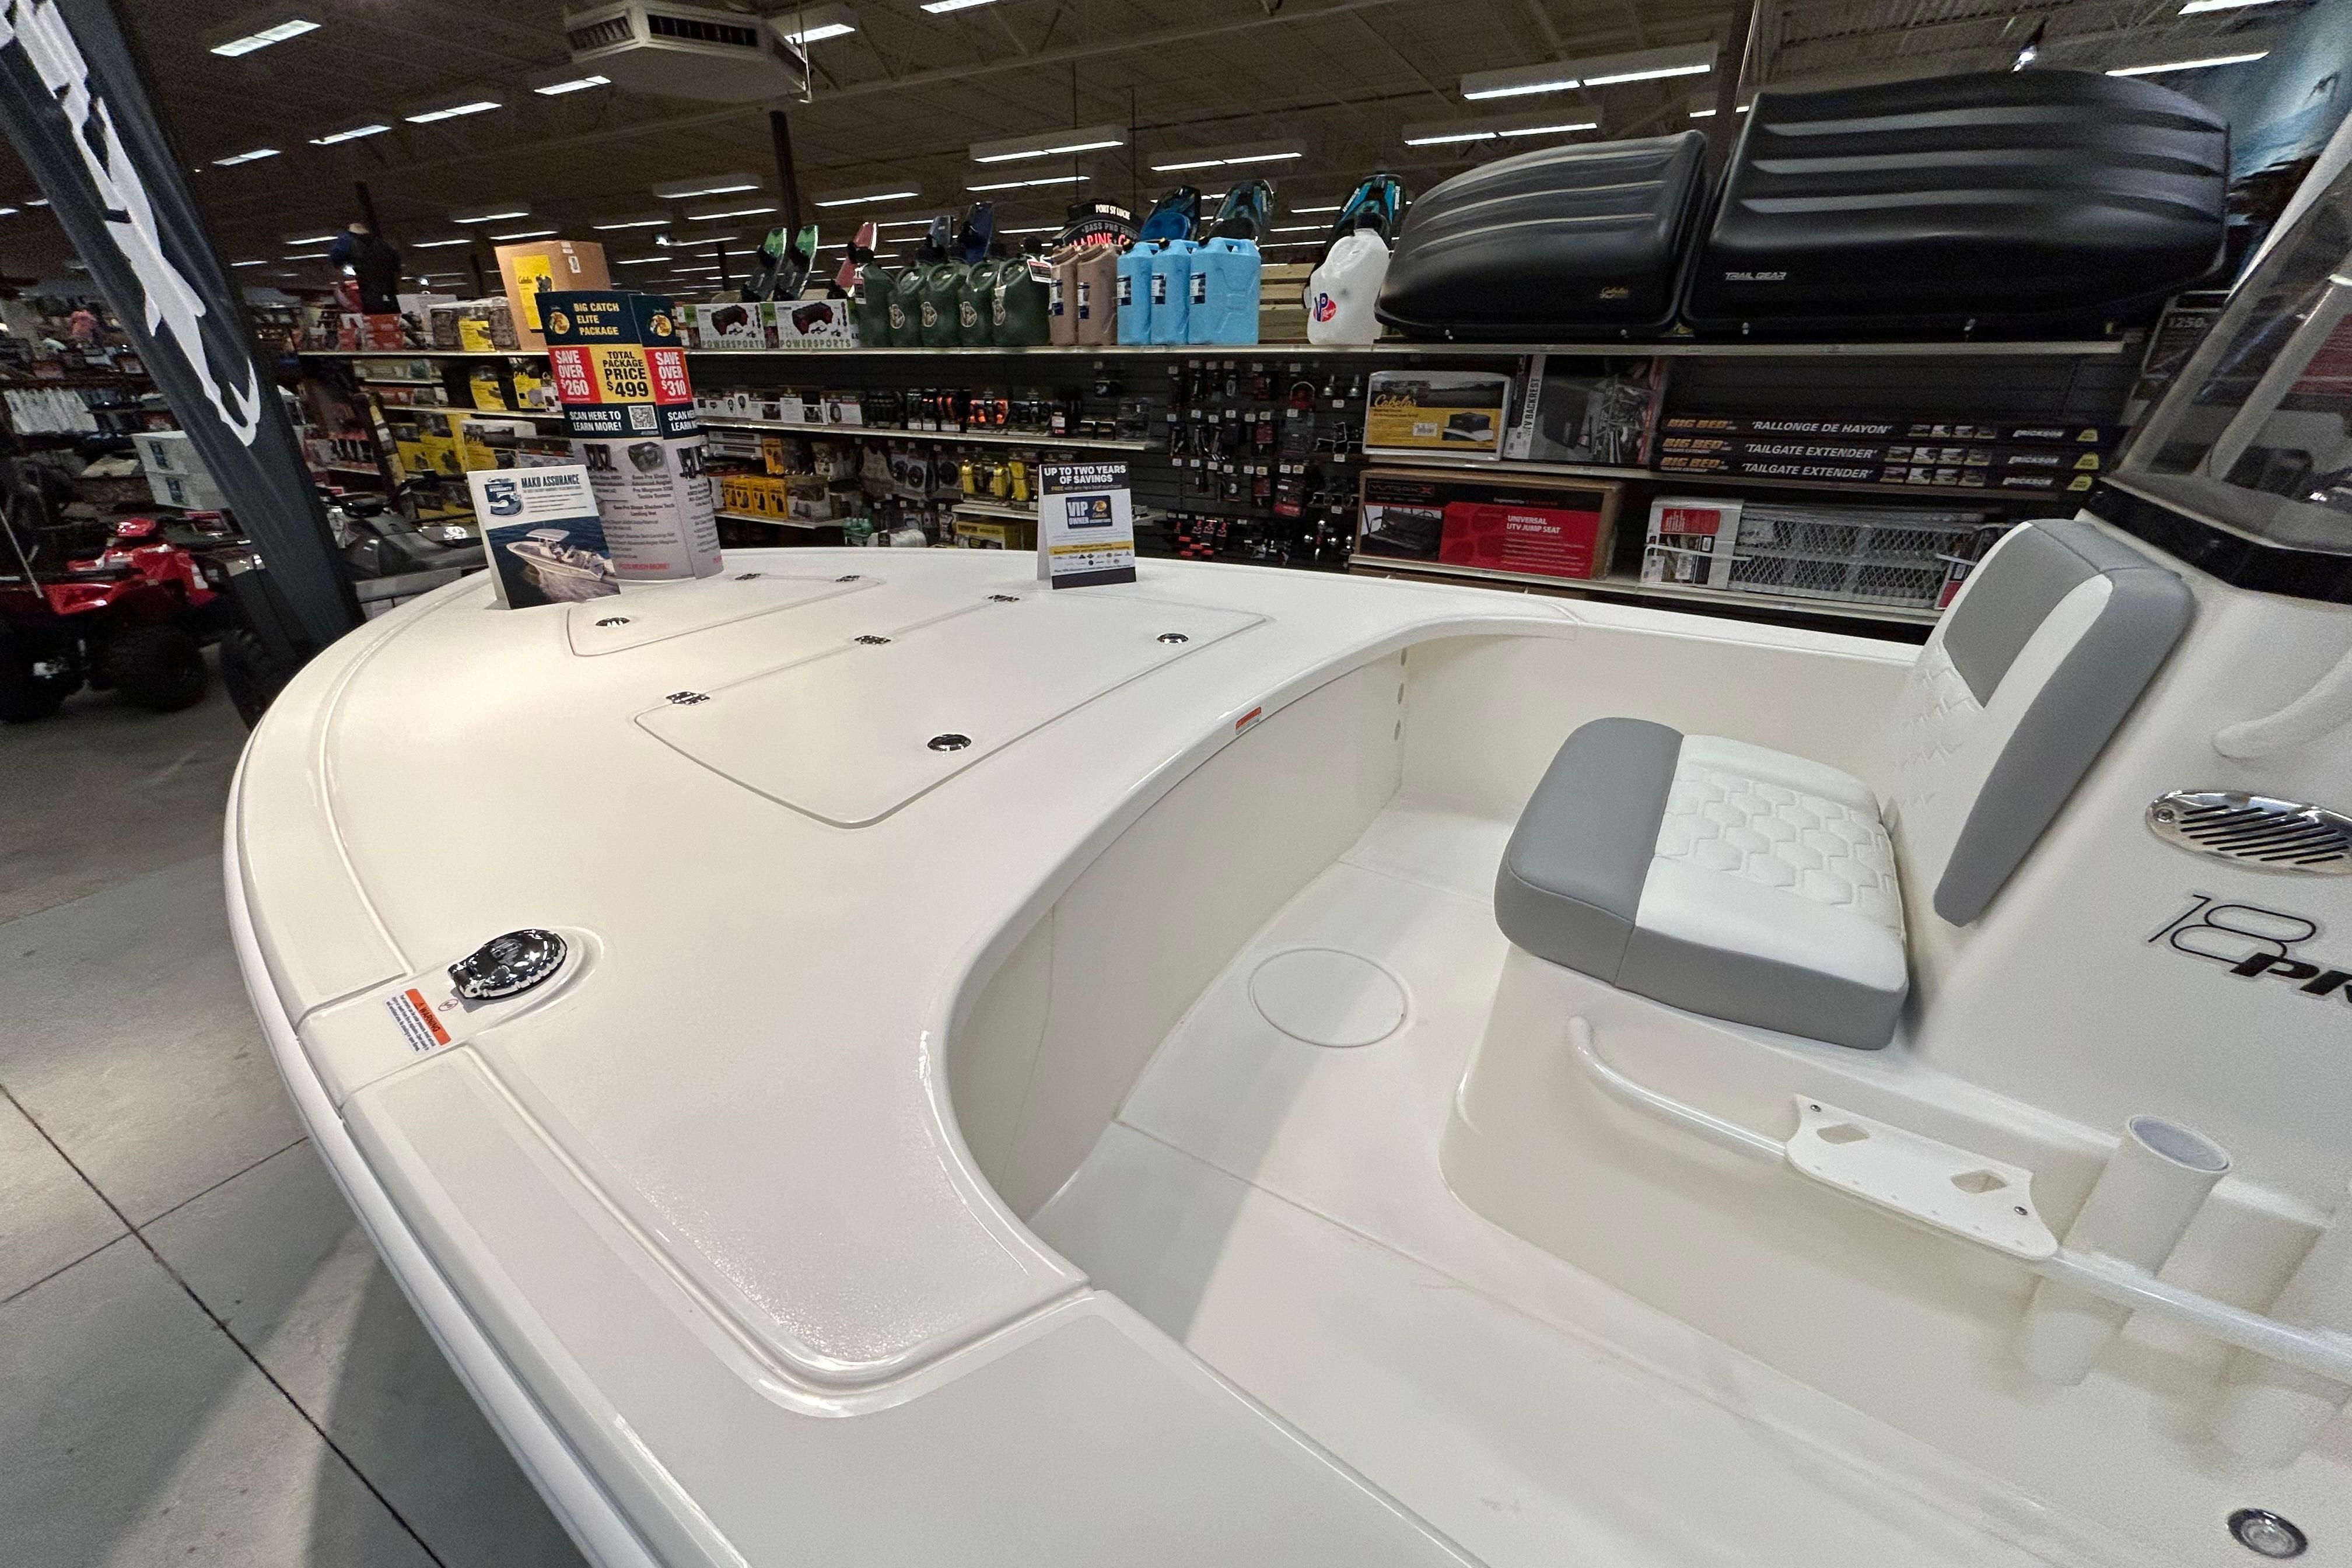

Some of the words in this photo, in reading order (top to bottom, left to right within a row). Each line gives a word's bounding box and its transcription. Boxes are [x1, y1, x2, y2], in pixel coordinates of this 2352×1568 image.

[1096, 204, 1109, 214] PORT
[1110, 205, 1116, 215] ST
[1084, 222, 1102, 233] BASS
[1105, 222, 1118, 232] PRO
[1726, 272, 1753, 280] TRAIL
[1755, 272, 1787, 280] GEAR
[573, 303, 589, 312] BIG
[590, 302, 620, 312] CATCH
[576, 315, 600, 324] ELITE
[579, 326, 620, 336] PACKAGE
[701, 340, 765, 349] POWERSPORTS
[780, 338, 852, 348] POWERSPORTS
[555, 350, 581, 365] SAVE
[607, 351, 635, 359] TOTAL
[654, 351, 681, 366] SAVE
[603, 359, 644, 368] PACKAGE
[558, 364, 584, 379] OVER
[604, 368, 648, 380] PRICE
[658, 365, 684, 380] OVER
[561, 379, 589, 396] $260
[607, 381, 649, 397] $499
[661, 379, 687, 396] $310
[1524, 378, 1541, 419] BACKREST
[569, 411, 587, 421] SCAN
[588, 411, 608, 421] HERE
[608, 410, 622, 421] TO
[667, 411, 687, 422] SCAN
[572, 421, 594, 432] LEARN
[594, 421, 622, 432] MORE!
[1821, 423, 1840, 433] DE
[1044, 467, 1058, 476] UP
[1059, 467, 1072, 475] TO
[1073, 466, 1095, 475] TWO
[1096, 465, 1126, 474] YEARS
[521, 475, 542, 489] MAKO
[542, 474, 580, 487] ASSURANCE
[1059, 476, 1072, 484] OF
[1073, 474, 1113, 484] SAVINGS
[1067, 502, 1088, 517] VIP
[1507, 515, 1548, 525] UNIVERSAL
[1522, 524, 1542, 532] JUMP
[2148, 894, 2316, 965] 18
[418, 1006, 441, 1032] WARNING
